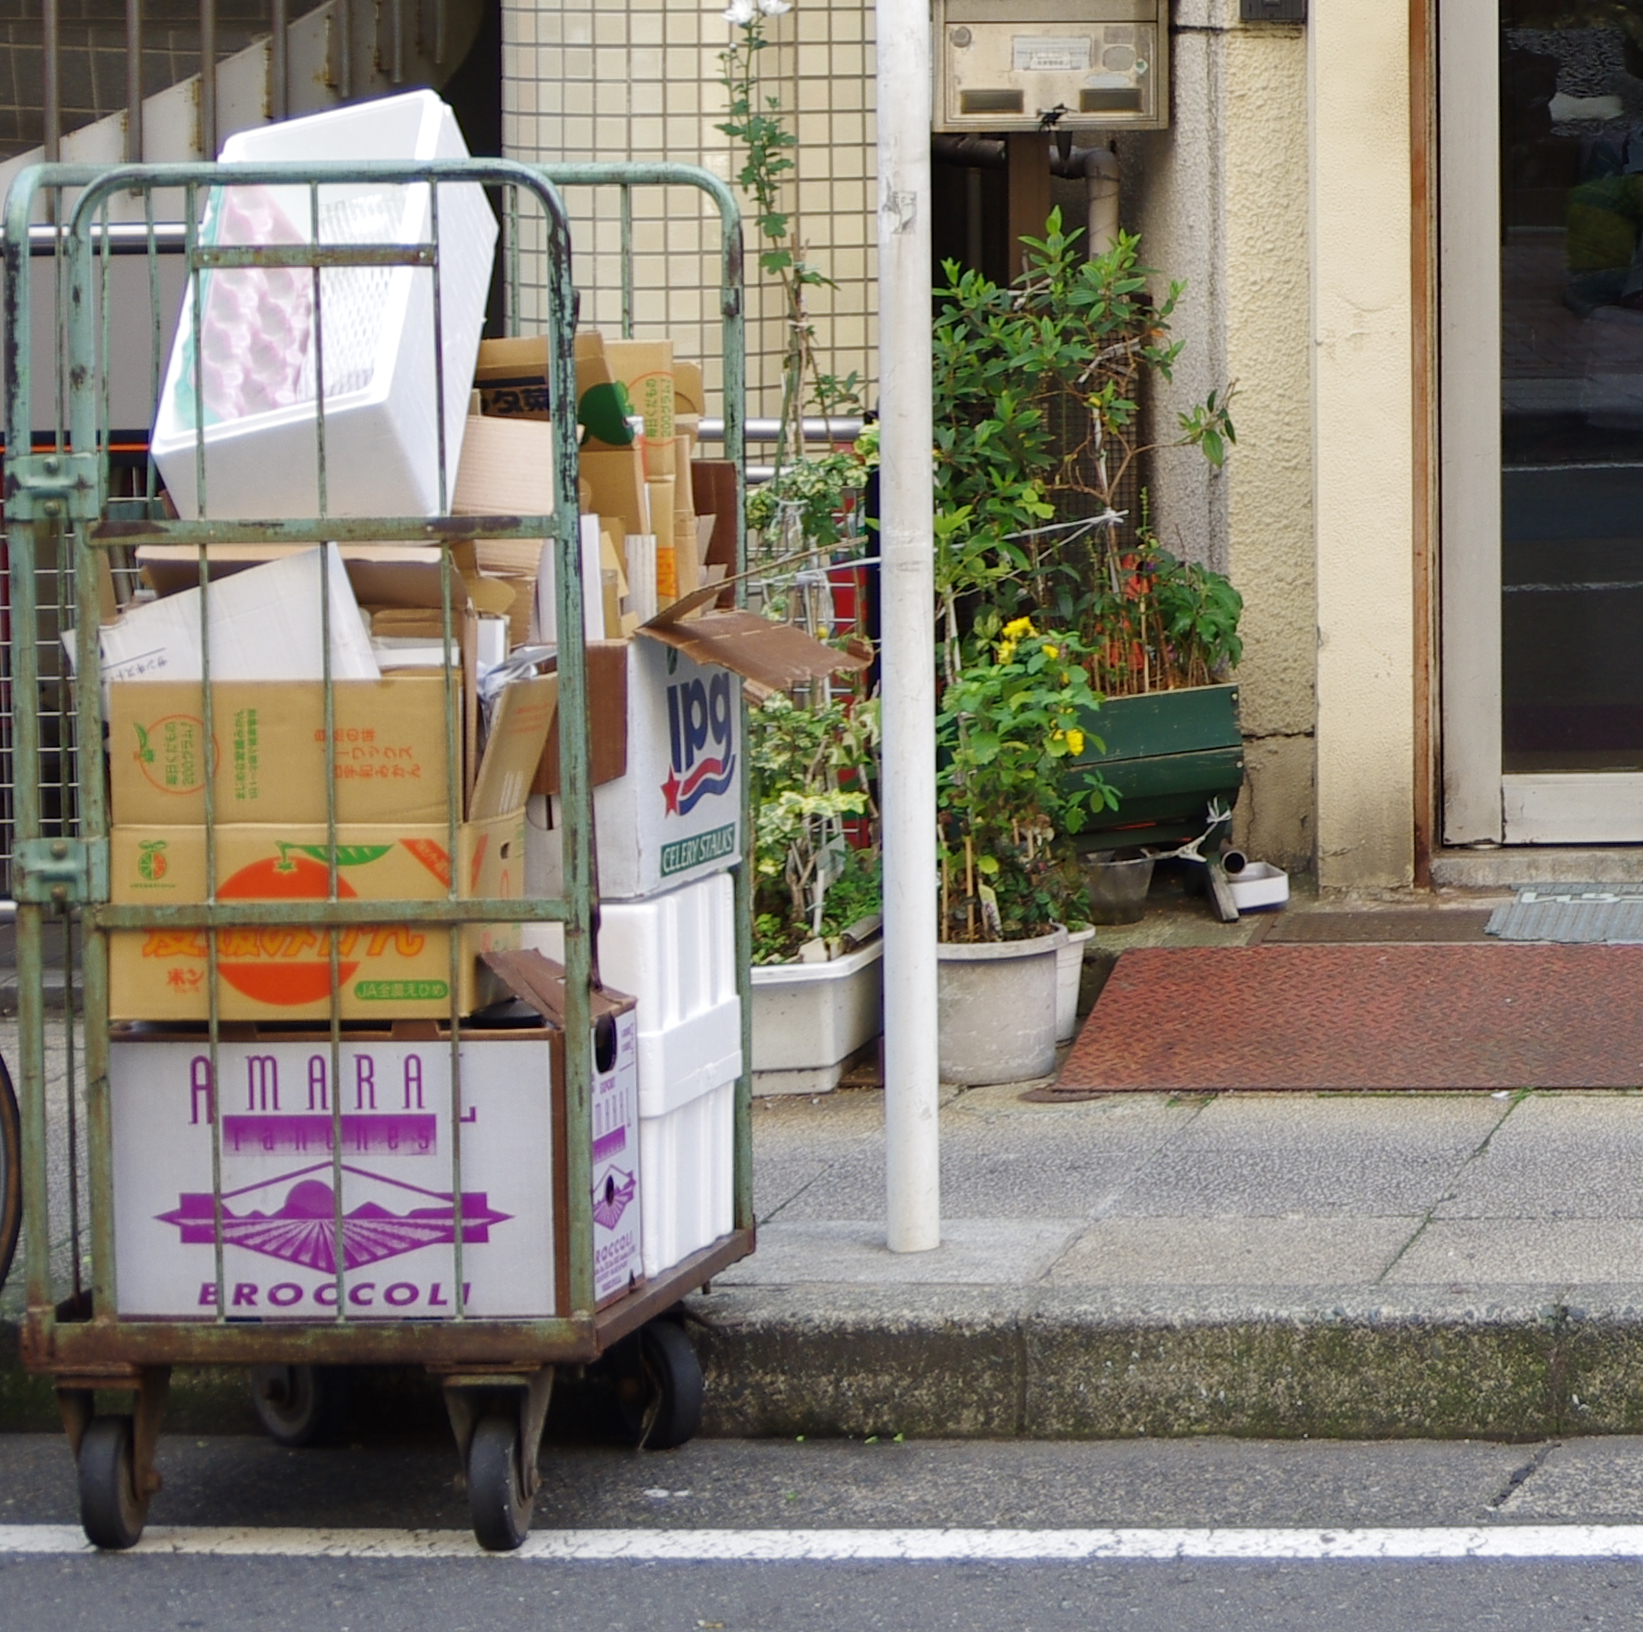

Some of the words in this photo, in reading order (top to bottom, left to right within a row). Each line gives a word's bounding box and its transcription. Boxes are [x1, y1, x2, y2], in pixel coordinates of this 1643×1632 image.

[662, 839, 700, 875] CELERY
[699, 826, 734, 860] STALKS
[357, 983, 447, 1000] JA全農えひめ
[198, 1281, 472, 1307] BROCCOLI
